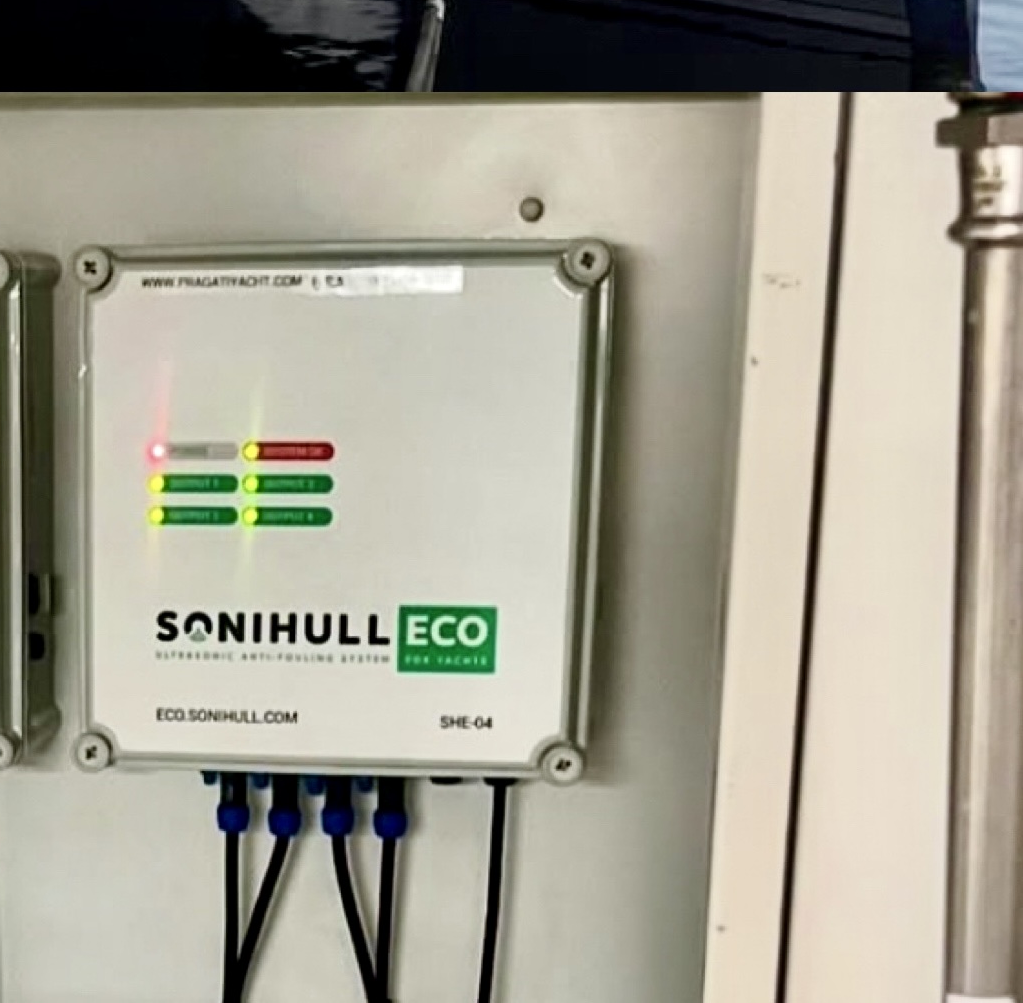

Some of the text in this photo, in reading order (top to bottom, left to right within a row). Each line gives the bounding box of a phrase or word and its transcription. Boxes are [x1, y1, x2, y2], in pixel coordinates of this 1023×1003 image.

[155, 610, 489, 648] SONIHULL ECO
[155, 650, 234, 662] ULTRASONIC
[340, 653, 391, 665] SYSTEM
[155, 707, 299, 725] ECO.SONIHULL.COM
[439, 714, 494, 730] SHE-04
